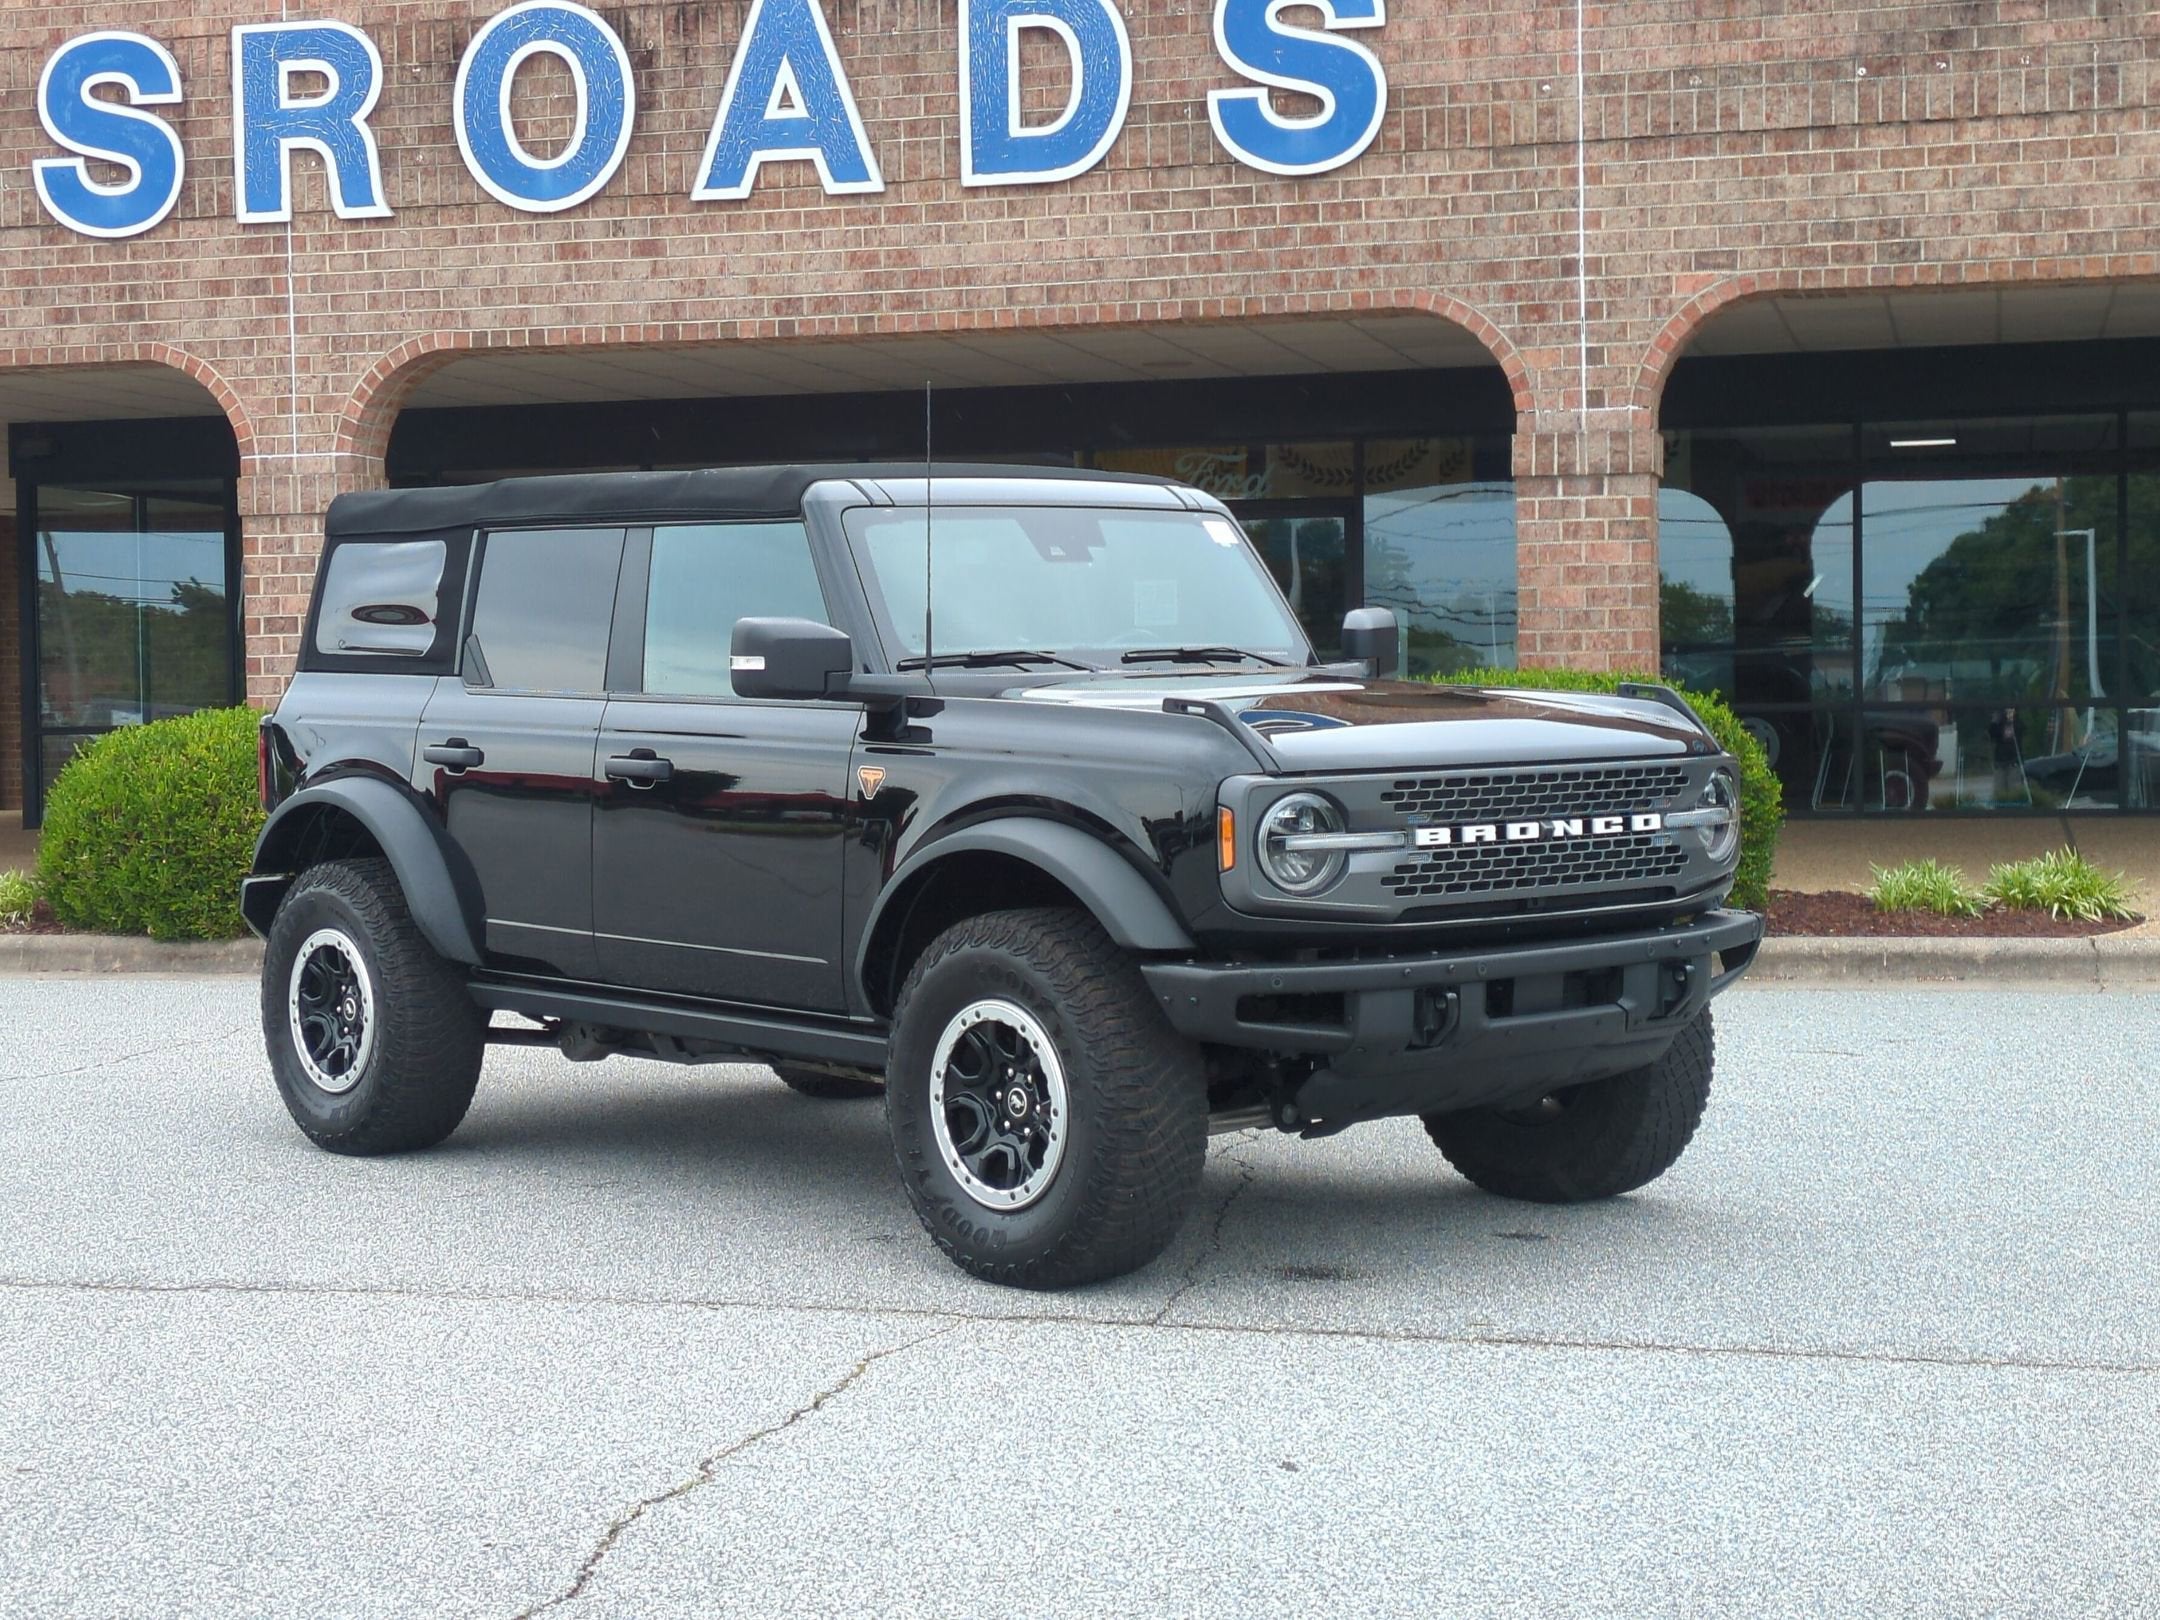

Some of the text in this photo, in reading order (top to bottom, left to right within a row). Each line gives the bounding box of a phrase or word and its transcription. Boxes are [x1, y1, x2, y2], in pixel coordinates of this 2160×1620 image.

[32, 0, 1387, 239] SROADS
[1174, 452, 1276, 499] Ford
[1415, 813, 1661, 846] BRONCO
